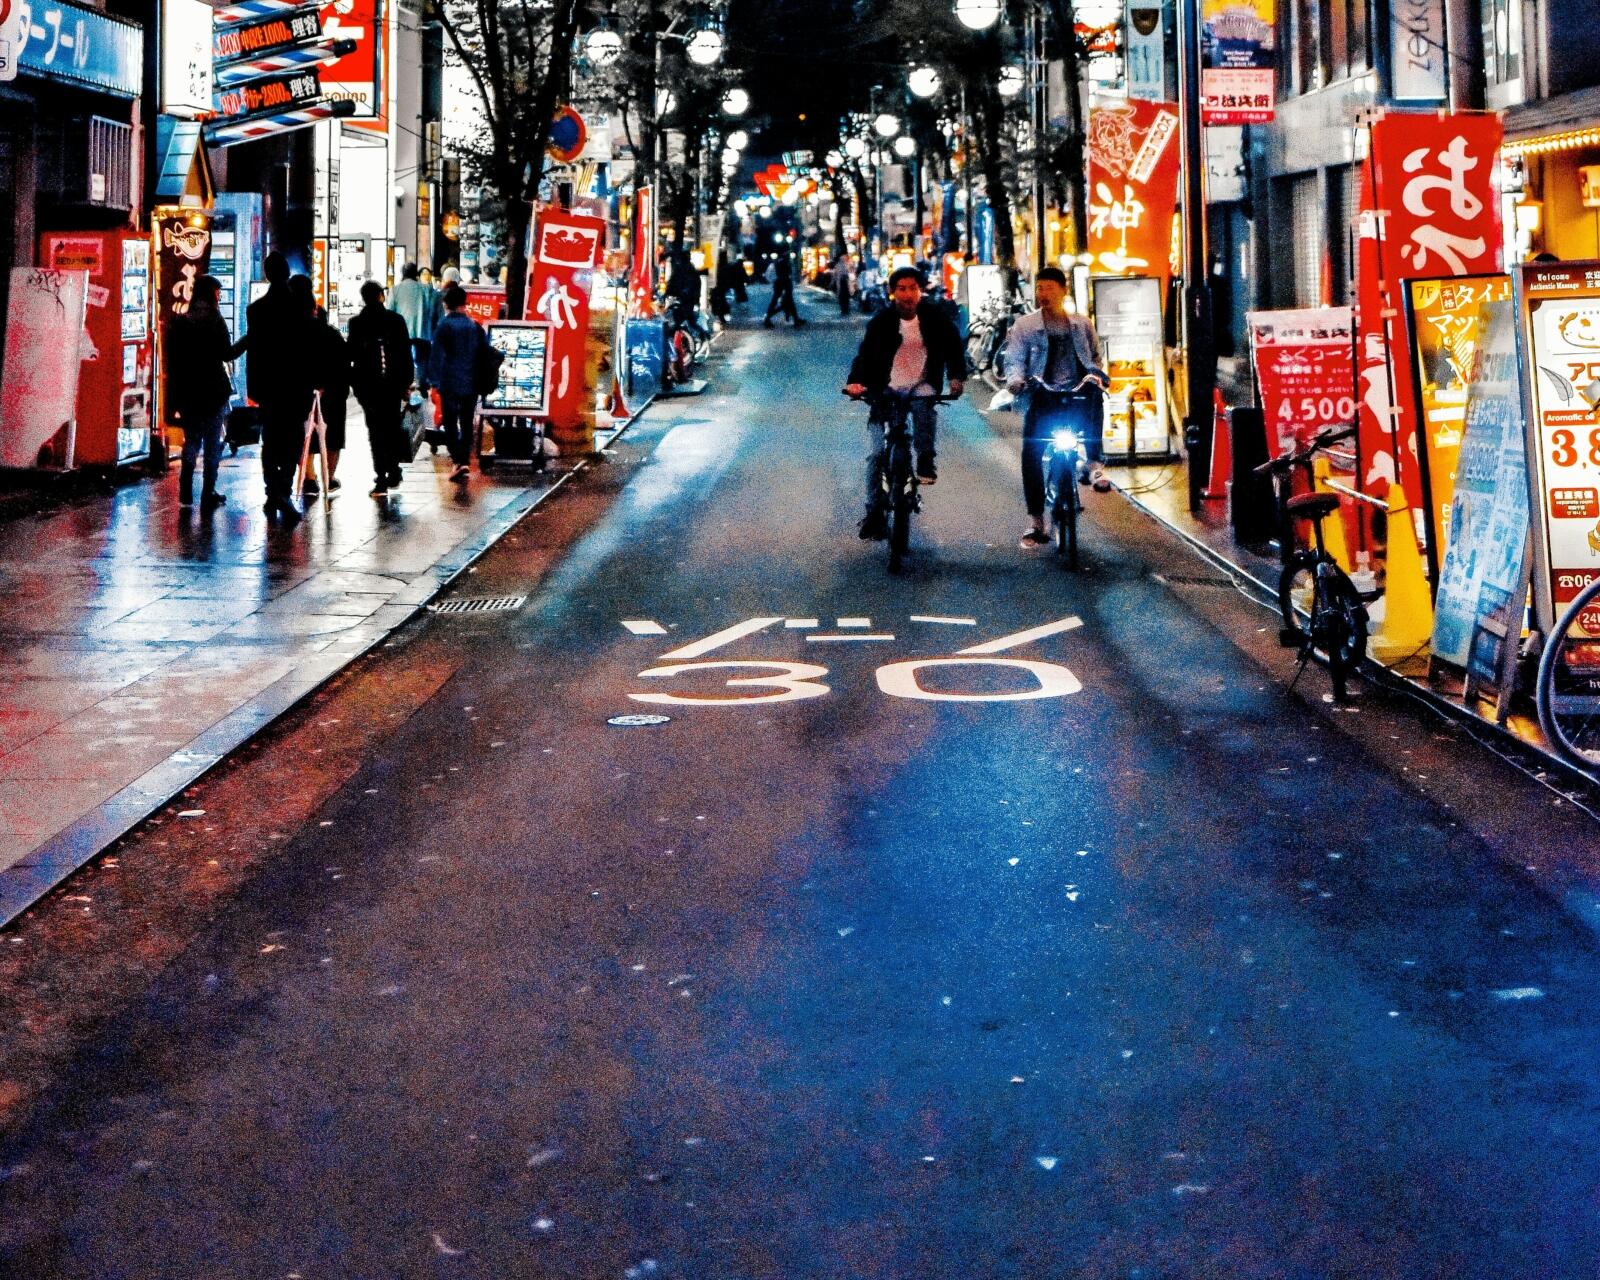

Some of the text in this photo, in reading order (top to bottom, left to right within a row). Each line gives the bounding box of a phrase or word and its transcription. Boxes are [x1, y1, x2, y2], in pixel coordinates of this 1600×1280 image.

[291, 14, 318, 38] 理容
[289, 75, 316, 99] 理容
[1537, 273, 1570, 281] Welcome
[1546, 413, 1583, 423] Aromatic
[626, 657, 1084, 707] 30
